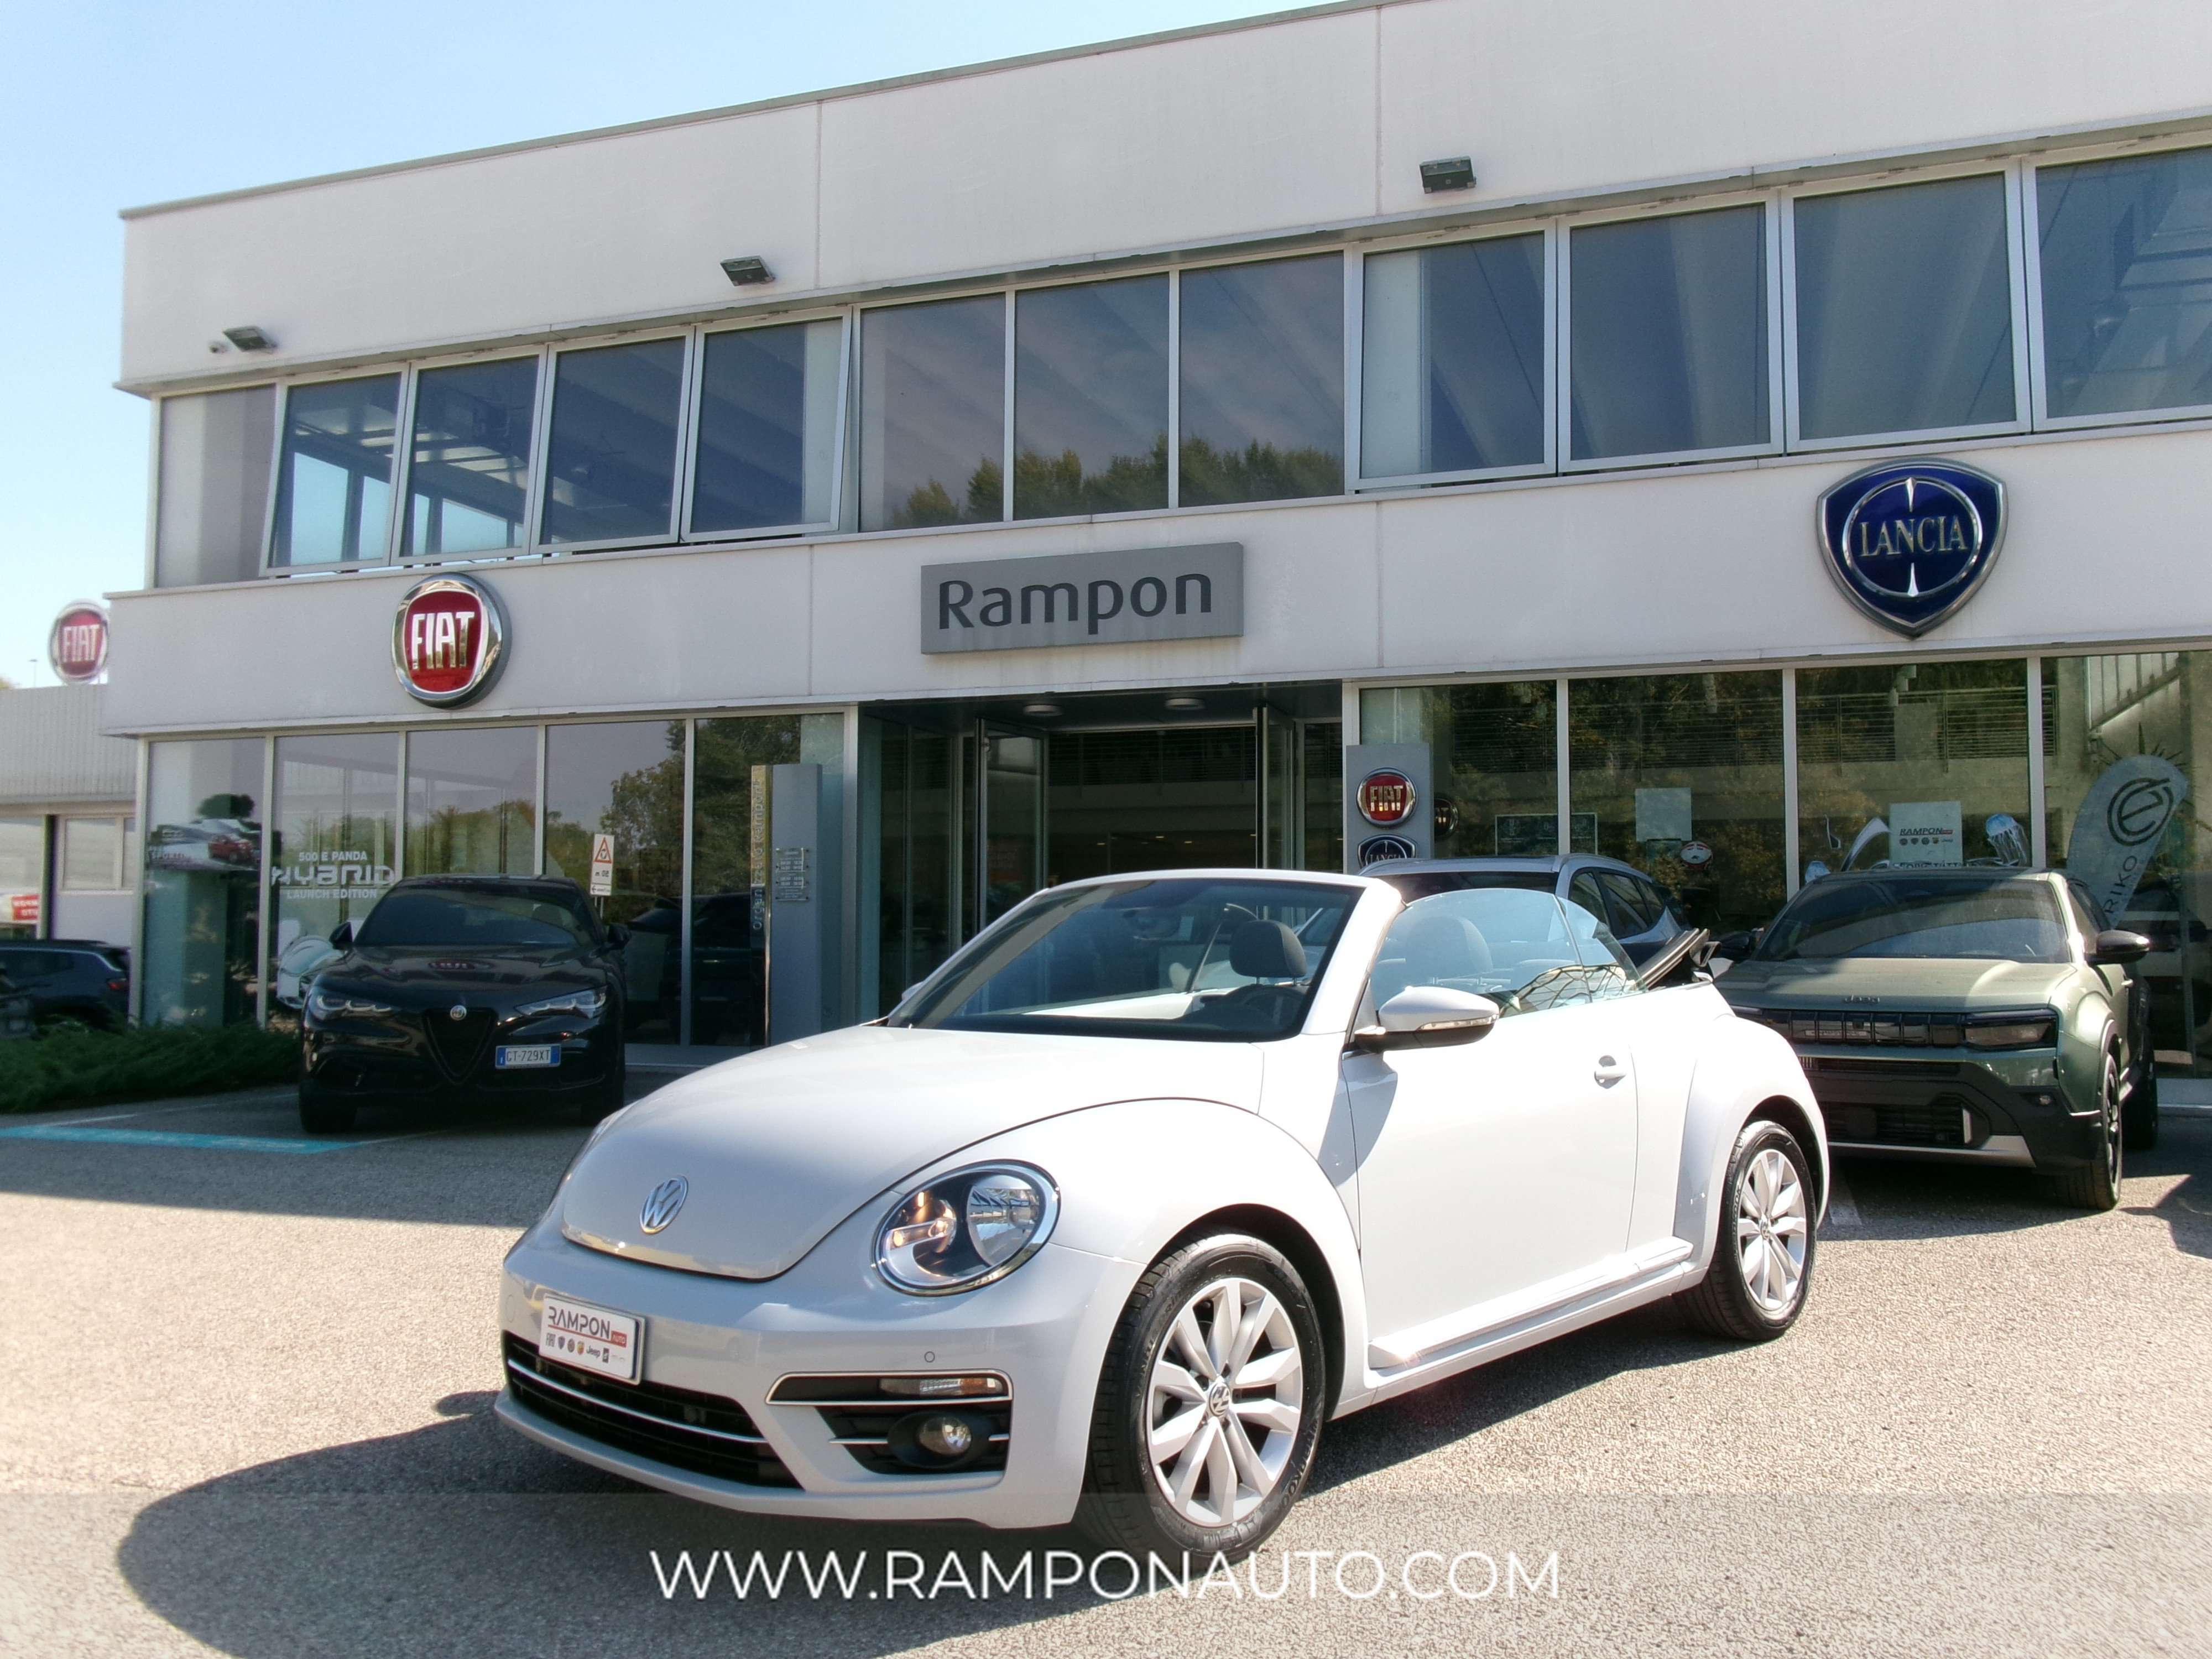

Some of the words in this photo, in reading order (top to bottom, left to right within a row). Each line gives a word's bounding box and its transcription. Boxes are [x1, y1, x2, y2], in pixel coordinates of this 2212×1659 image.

[1859, 515, 1968, 557] LANCIA
[938, 573, 1212, 635] Rampon
[62, 624, 100, 662] FIAT
[411, 611, 475, 670] FIAT
[1370, 785, 1404, 812] FIAT
[1900, 827, 1943, 836] RAMPON
[299, 852, 318, 861] 500
[321, 851, 328, 860] E
[332, 851, 367, 860] PANDA
[271, 864, 394, 885] HYBRID
[286, 889, 330, 899] LAUNCH
[333, 889, 377, 899] EDITION
[548, 1306, 611, 1339] RAMPON
[612, 1334, 627, 1345] AUTO
[586, 1345, 601, 1359] Jeep
